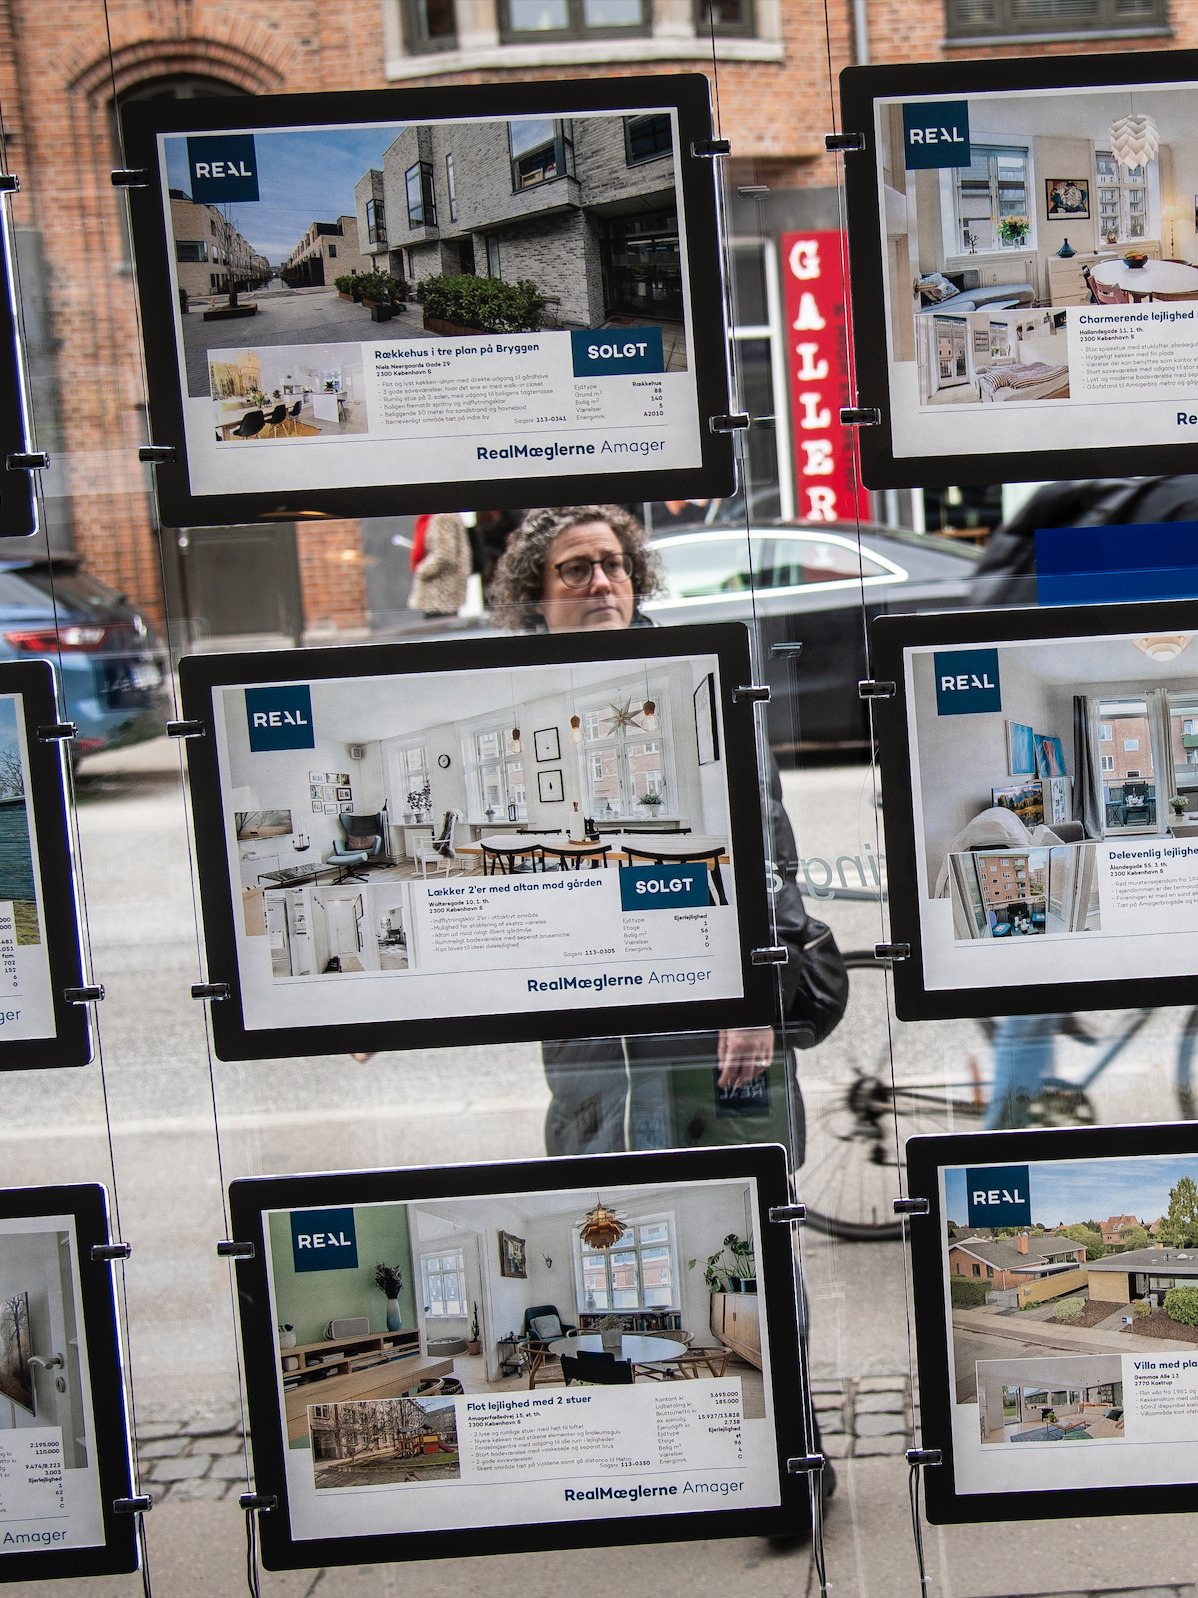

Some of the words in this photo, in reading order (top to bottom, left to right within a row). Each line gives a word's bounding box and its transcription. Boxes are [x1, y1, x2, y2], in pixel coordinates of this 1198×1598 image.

[910, 127, 964, 144] REAL
[196, 161, 251, 178] REAL
[1079, 312, 1148, 324] Charmerende
[1151, 310, 1194, 322] lejlighed
[374, 348, 428, 358] Rækkehus
[431, 347, 434, 356] i
[437, 347, 452, 355] tre
[455, 345, 477, 357] plan
[480, 343, 493, 356] på
[496, 344, 539, 354] Bryggen
[588, 342, 647, 359] SOLGT
[476, 442, 595, 460] RealMæglerne
[600, 440, 665, 455] Amager
[942, 674, 994, 690] REAL
[254, 710, 307, 727] REAL
[1109, 848, 1161, 859] Delevenlig
[427, 887, 465, 896] Lækker
[468, 885, 486, 894] 2'er
[489, 883, 510, 892] med
[513, 882, 539, 891] altan
[542, 880, 564, 889] mod
[566, 878, 602, 890] gården
[636, 878, 693, 894] SOLGT
[527, 973, 642, 992] RealMæglerne
[648, 970, 711, 985] Amager
[973, 1189, 1025, 1205] REAL
[298, 1232, 351, 1248] REAL
[1133, 1361, 1155, 1369] Villa
[1159, 1360, 1179, 1368] med
[466, 1402, 485, 1411] Flot
[488, 1399, 529, 1411] lejlighed
[532, 1396, 553, 1406] med
[556, 1396, 562, 1404] 2
[566, 1396, 591, 1404] stuer
[564, 1484, 677, 1501] RealMæglerne
[682, 1481, 744, 1495] Amager
[2, 1530, 67, 1545] Amager
